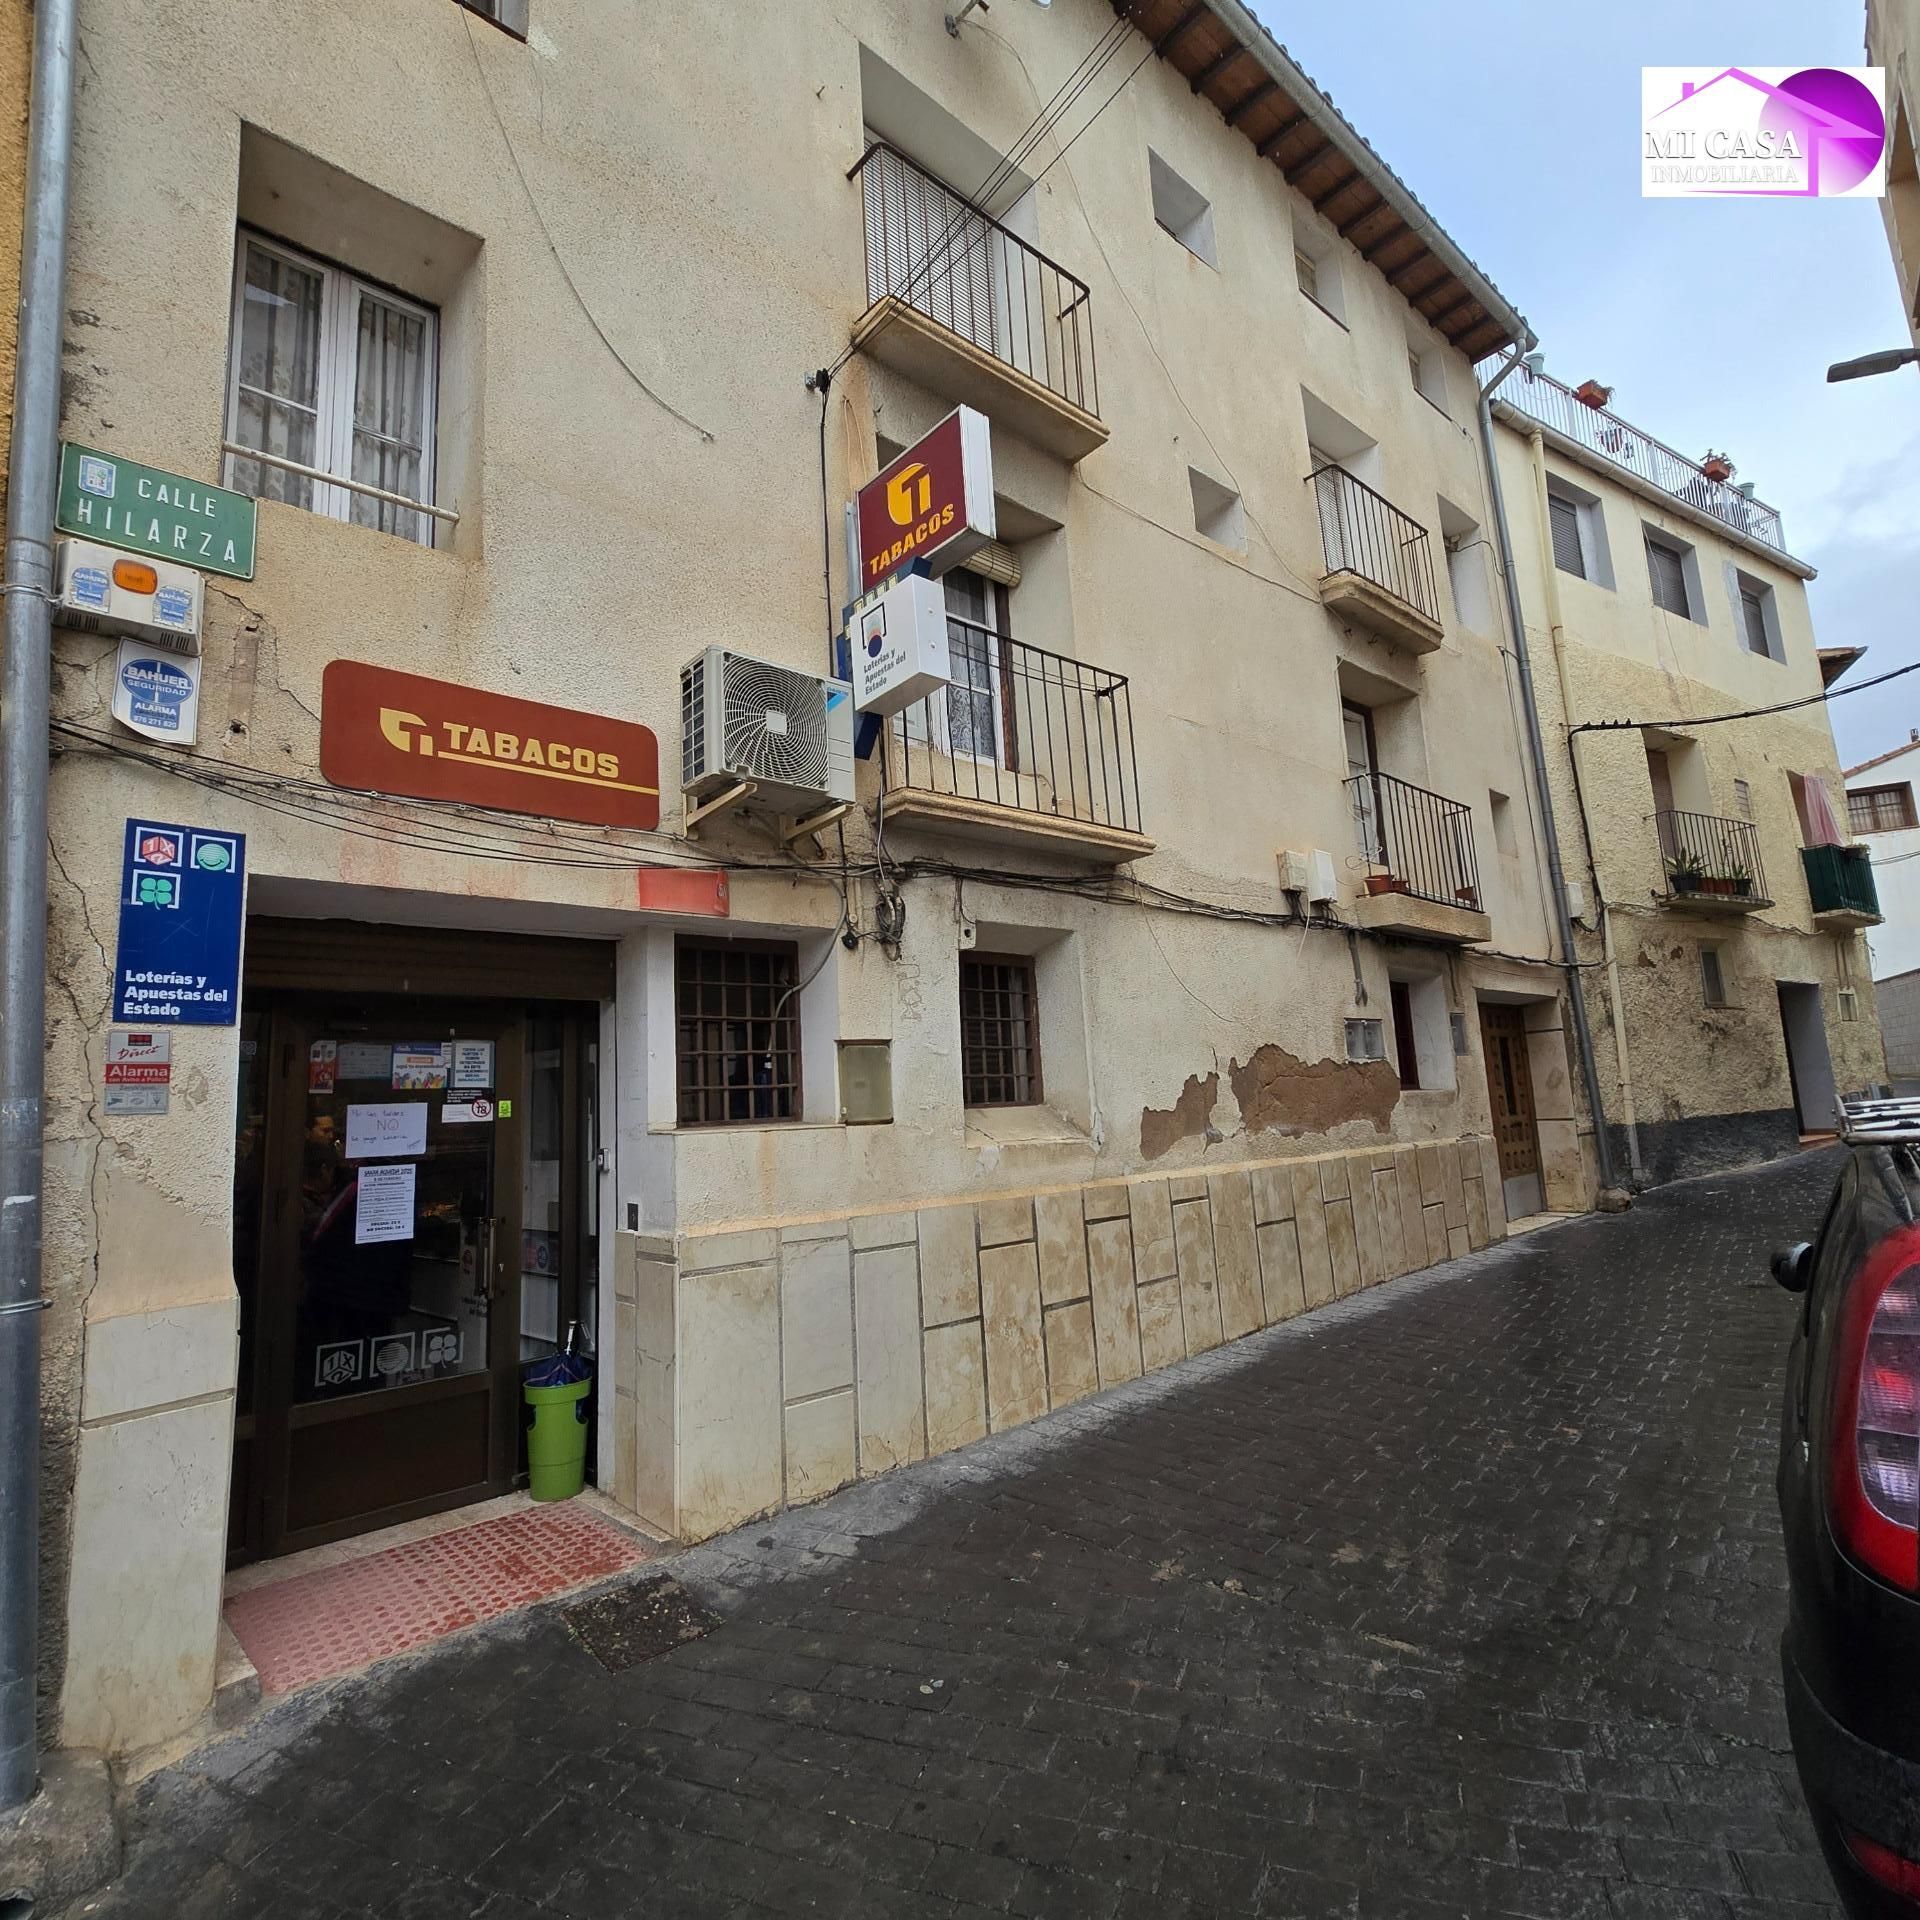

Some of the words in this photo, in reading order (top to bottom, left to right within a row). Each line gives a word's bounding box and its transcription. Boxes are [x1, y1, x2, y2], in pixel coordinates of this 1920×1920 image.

[138, 478, 217, 518] CALLE
[77, 497, 236, 564] HILARZA
[869, 503, 954, 575] TABACOS
[891, 648, 895, 659] y
[127, 665, 188, 688] BAHUER
[865, 661, 894, 685] Apuestas
[896, 650, 906, 665] del
[127, 679, 187, 696] SEGURIDAD
[865, 677, 887, 696] Estado
[134, 702, 177, 715] ALARMA
[442, 721, 619, 779] TABACOS
[125, 969, 193, 985] Loterías
[196, 976, 207, 988] y
[124, 986, 201, 1001] Apuestas
[203, 989, 228, 1002] del
[123, 1001, 181, 1015] Estado
[109, 1064, 168, 1077] Alarma
[377, 1119, 400, 1131] NO
